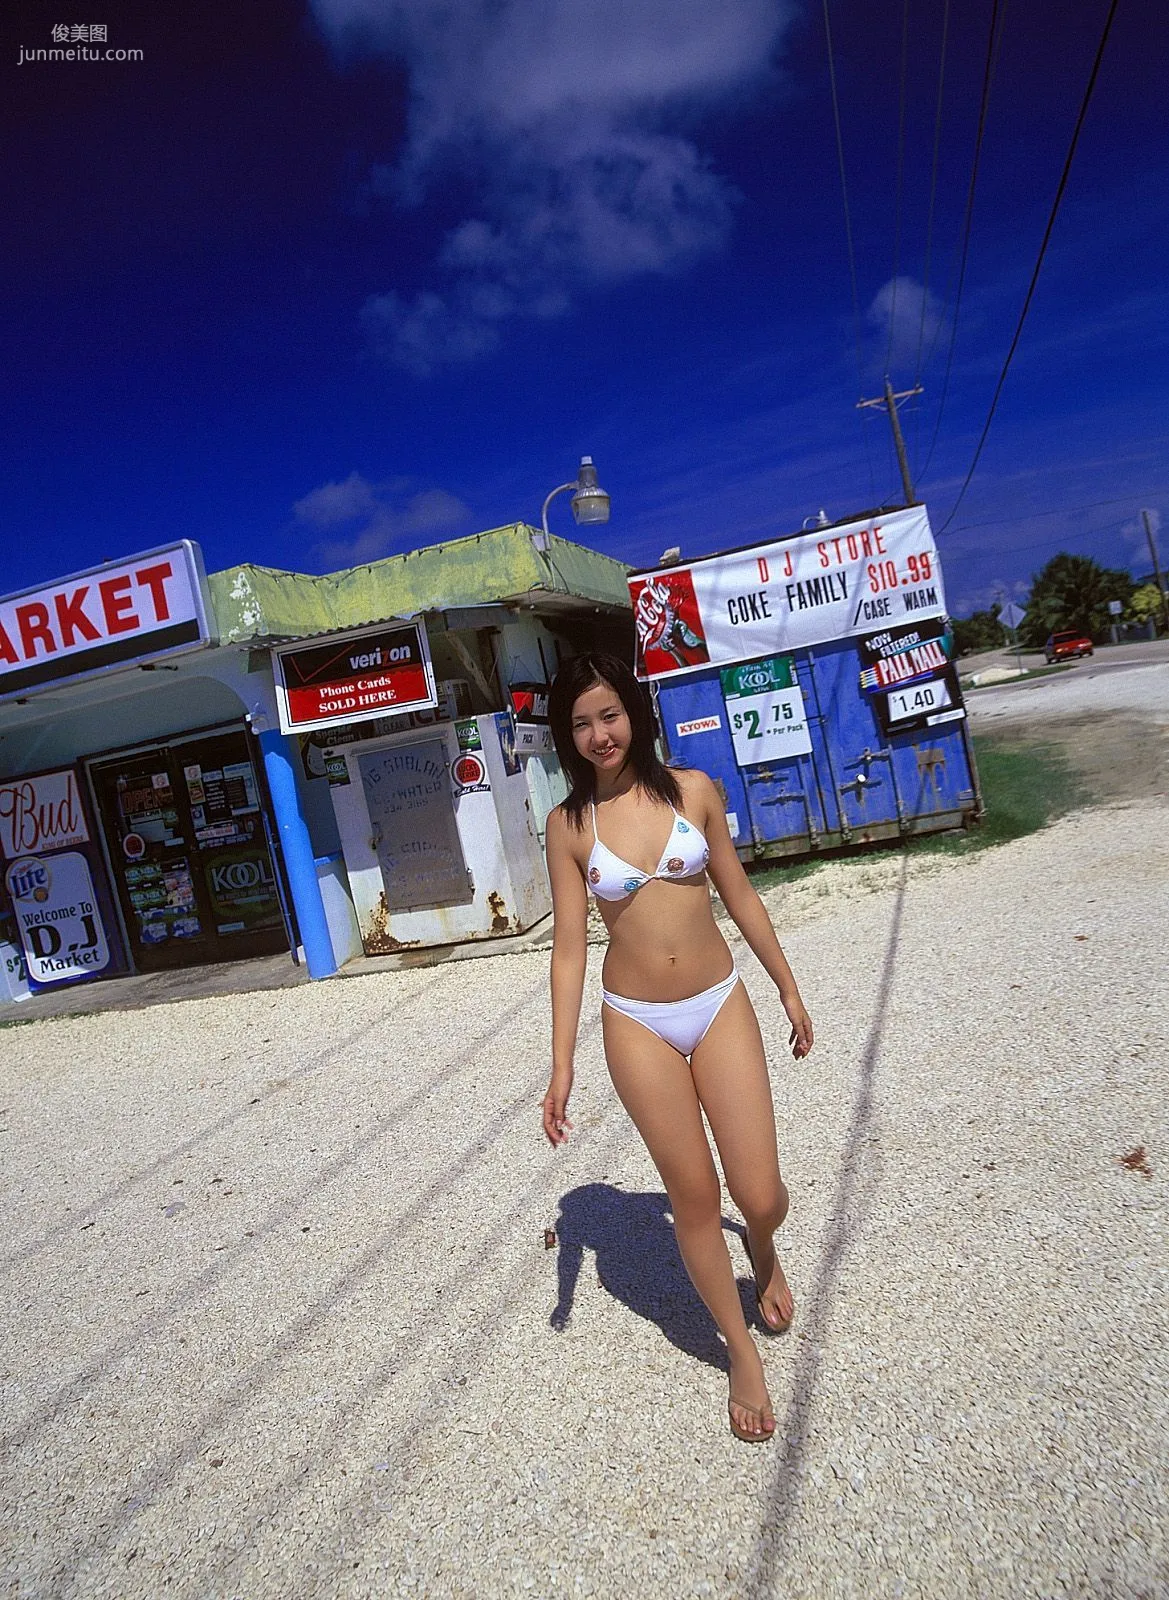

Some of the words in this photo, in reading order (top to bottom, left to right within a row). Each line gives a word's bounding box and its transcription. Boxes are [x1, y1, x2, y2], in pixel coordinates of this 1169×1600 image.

[817, 527, 887, 568] STORE
[727, 591, 772, 625] COKE
[786, 571, 848, 612] FAMILY
[867, 552, 932, 594] $10.99
[903, 587, 938, 612] WARM
[865, 632, 892, 651] NOW
[880, 632, 921, 658] FILTERED!
[350, 644, 411, 670] verizon
[878, 652, 914, 685] PALL
[909, 641, 947, 674] MALL
[319, 685, 355, 698] Phone
[357, 676, 391, 690] Cards
[739, 669, 780, 690] KOOL
[319, 697, 356, 713] SOLD
[358, 689, 397, 705] HERE
[457, 726, 479, 739] KOOL
[679, 719, 718, 734] KYOWA
[773, 726, 785, 735] Per
[787, 723, 804, 733] Pack
[0, 774, 78, 853] Bud
[211, 859, 275, 892] KOOL
[23, 906, 77, 927] Welcome
[79, 901, 93, 914] To
[40, 949, 101, 974] Market
